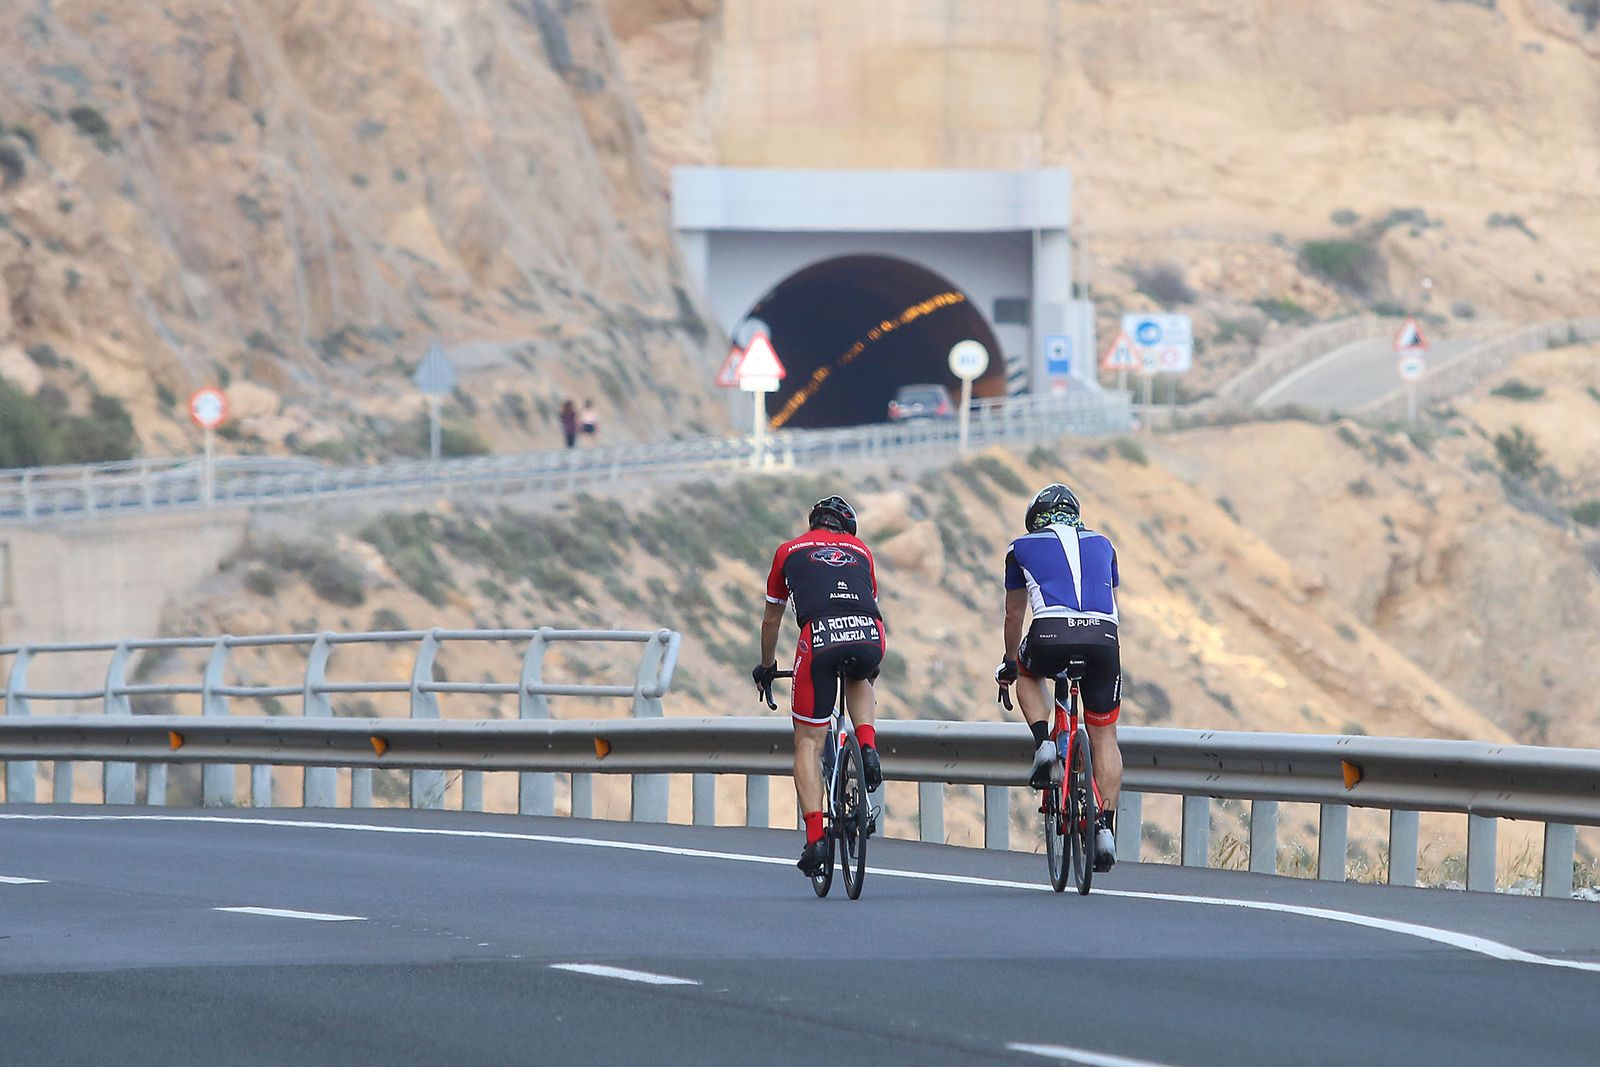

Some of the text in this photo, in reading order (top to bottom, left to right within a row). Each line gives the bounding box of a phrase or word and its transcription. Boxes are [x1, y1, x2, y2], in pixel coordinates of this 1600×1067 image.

[829, 592, 859, 600] ALMERIA
[811, 615, 876, 634] LA ROTONDA
[830, 630, 866, 643] ALMERIA
